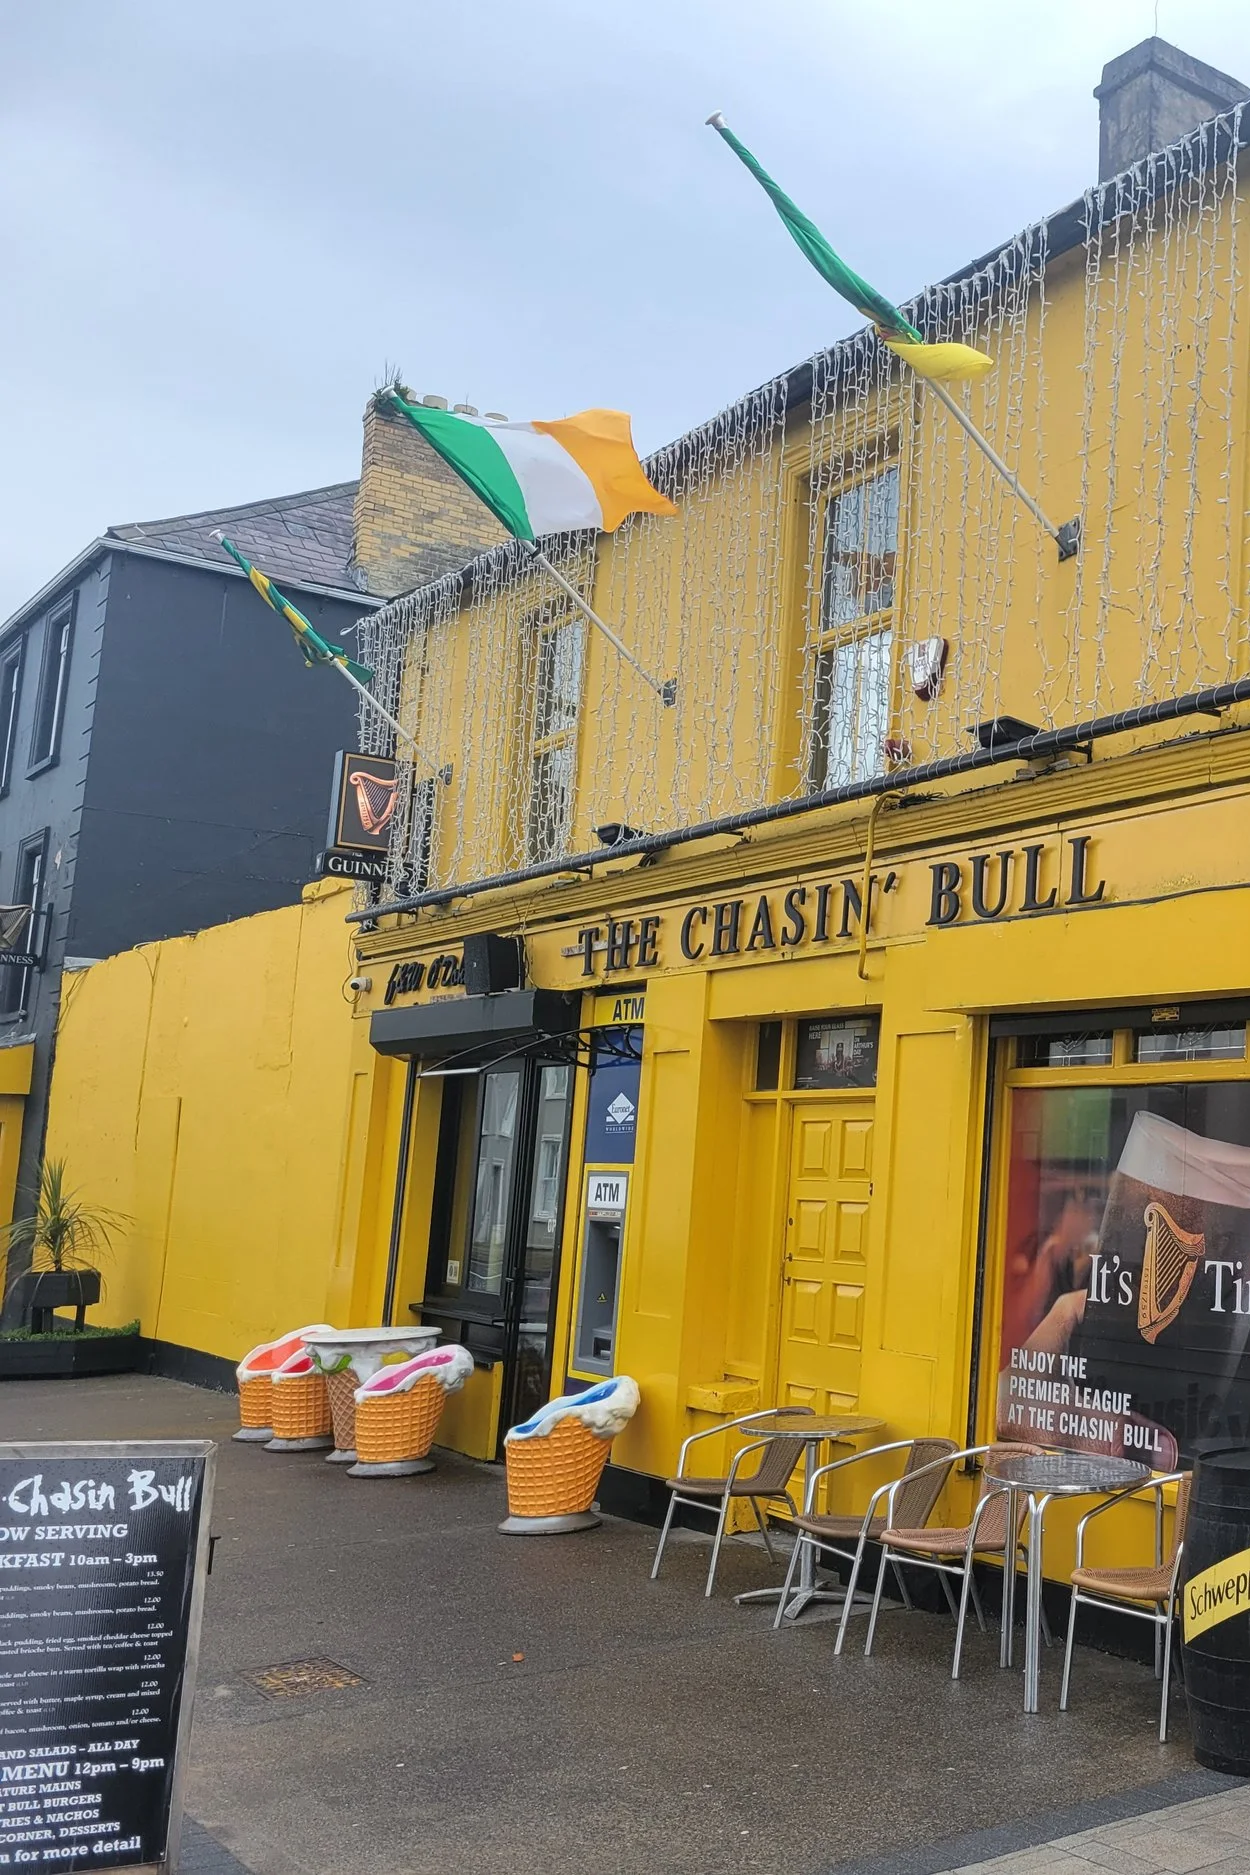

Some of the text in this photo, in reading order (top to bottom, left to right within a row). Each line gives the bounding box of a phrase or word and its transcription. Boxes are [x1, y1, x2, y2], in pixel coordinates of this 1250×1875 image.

[577, 836, 1105, 976] THE CHASIN' BULL
[612, 997, 645, 1022] ATM
[594, 1182, 620, 1202] ATM
[1011, 1348, 1087, 1379] ENJOY THE
[1009, 1375, 1132, 1416] PREMIER LEAGUE
[1007, 1403, 1162, 1452] AT THE CHASIN' BULL
[8, 1469, 192, 1516] Chasin Bull
[34, 1524, 129, 1540] SERVING
[70, 1554, 110, 1566] 10am
[125, 1553, 157, 1567] 3pm
[29, 1745, 77, 1758] SALADS
[88, 1742, 112, 1753] ALL
[114, 1739, 140, 1750] DAY
[1, 1758, 165, 1782] MENU 12pm 9pm
[38, 1780, 82, 1794] MAINS
[8, 1800, 40, 1812] BULL
[43, 1794, 102, 1809] BURGERS
[0, 1809, 100, 1828] RIES & NACHOS
[59, 1822, 121, 1838] DESSERTS
[14, 1849, 40, 1863] for
[43, 1845, 88, 1859] more
[93, 1836, 141, 1854] detail
